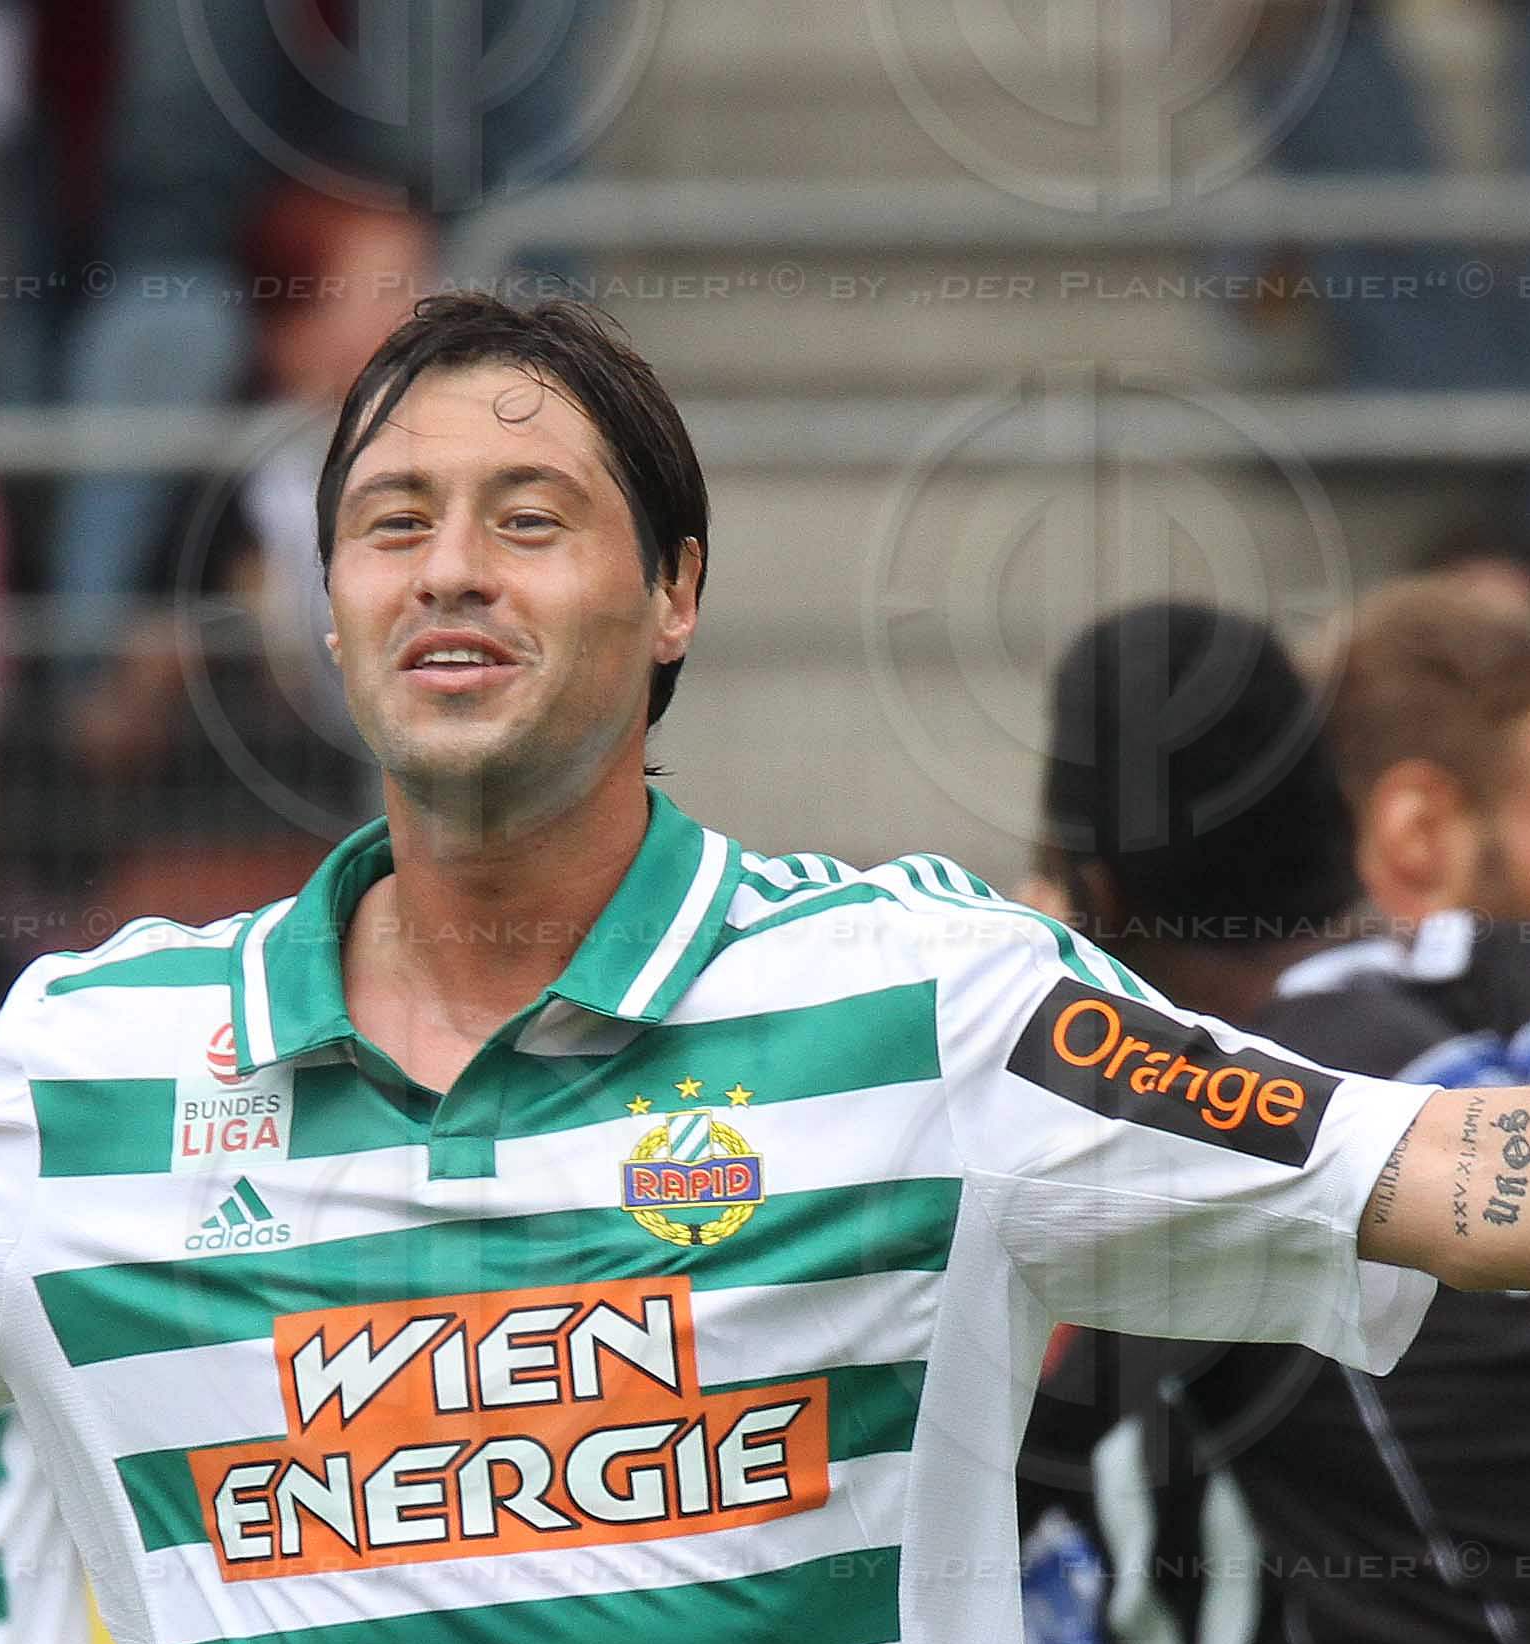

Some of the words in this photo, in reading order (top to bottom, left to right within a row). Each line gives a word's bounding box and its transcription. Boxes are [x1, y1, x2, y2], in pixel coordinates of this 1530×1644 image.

[1052, 998, 1306, 1130] Orange
[184, 1094, 281, 1121] BUNDES
[181, 1116, 281, 1157] LIGA
[632, 1163, 753, 1201] RAPID
[184, 1223, 292, 1251] adidas
[290, 1294, 683, 1433] WIEN
[212, 1396, 811, 1563] ENERGIE
